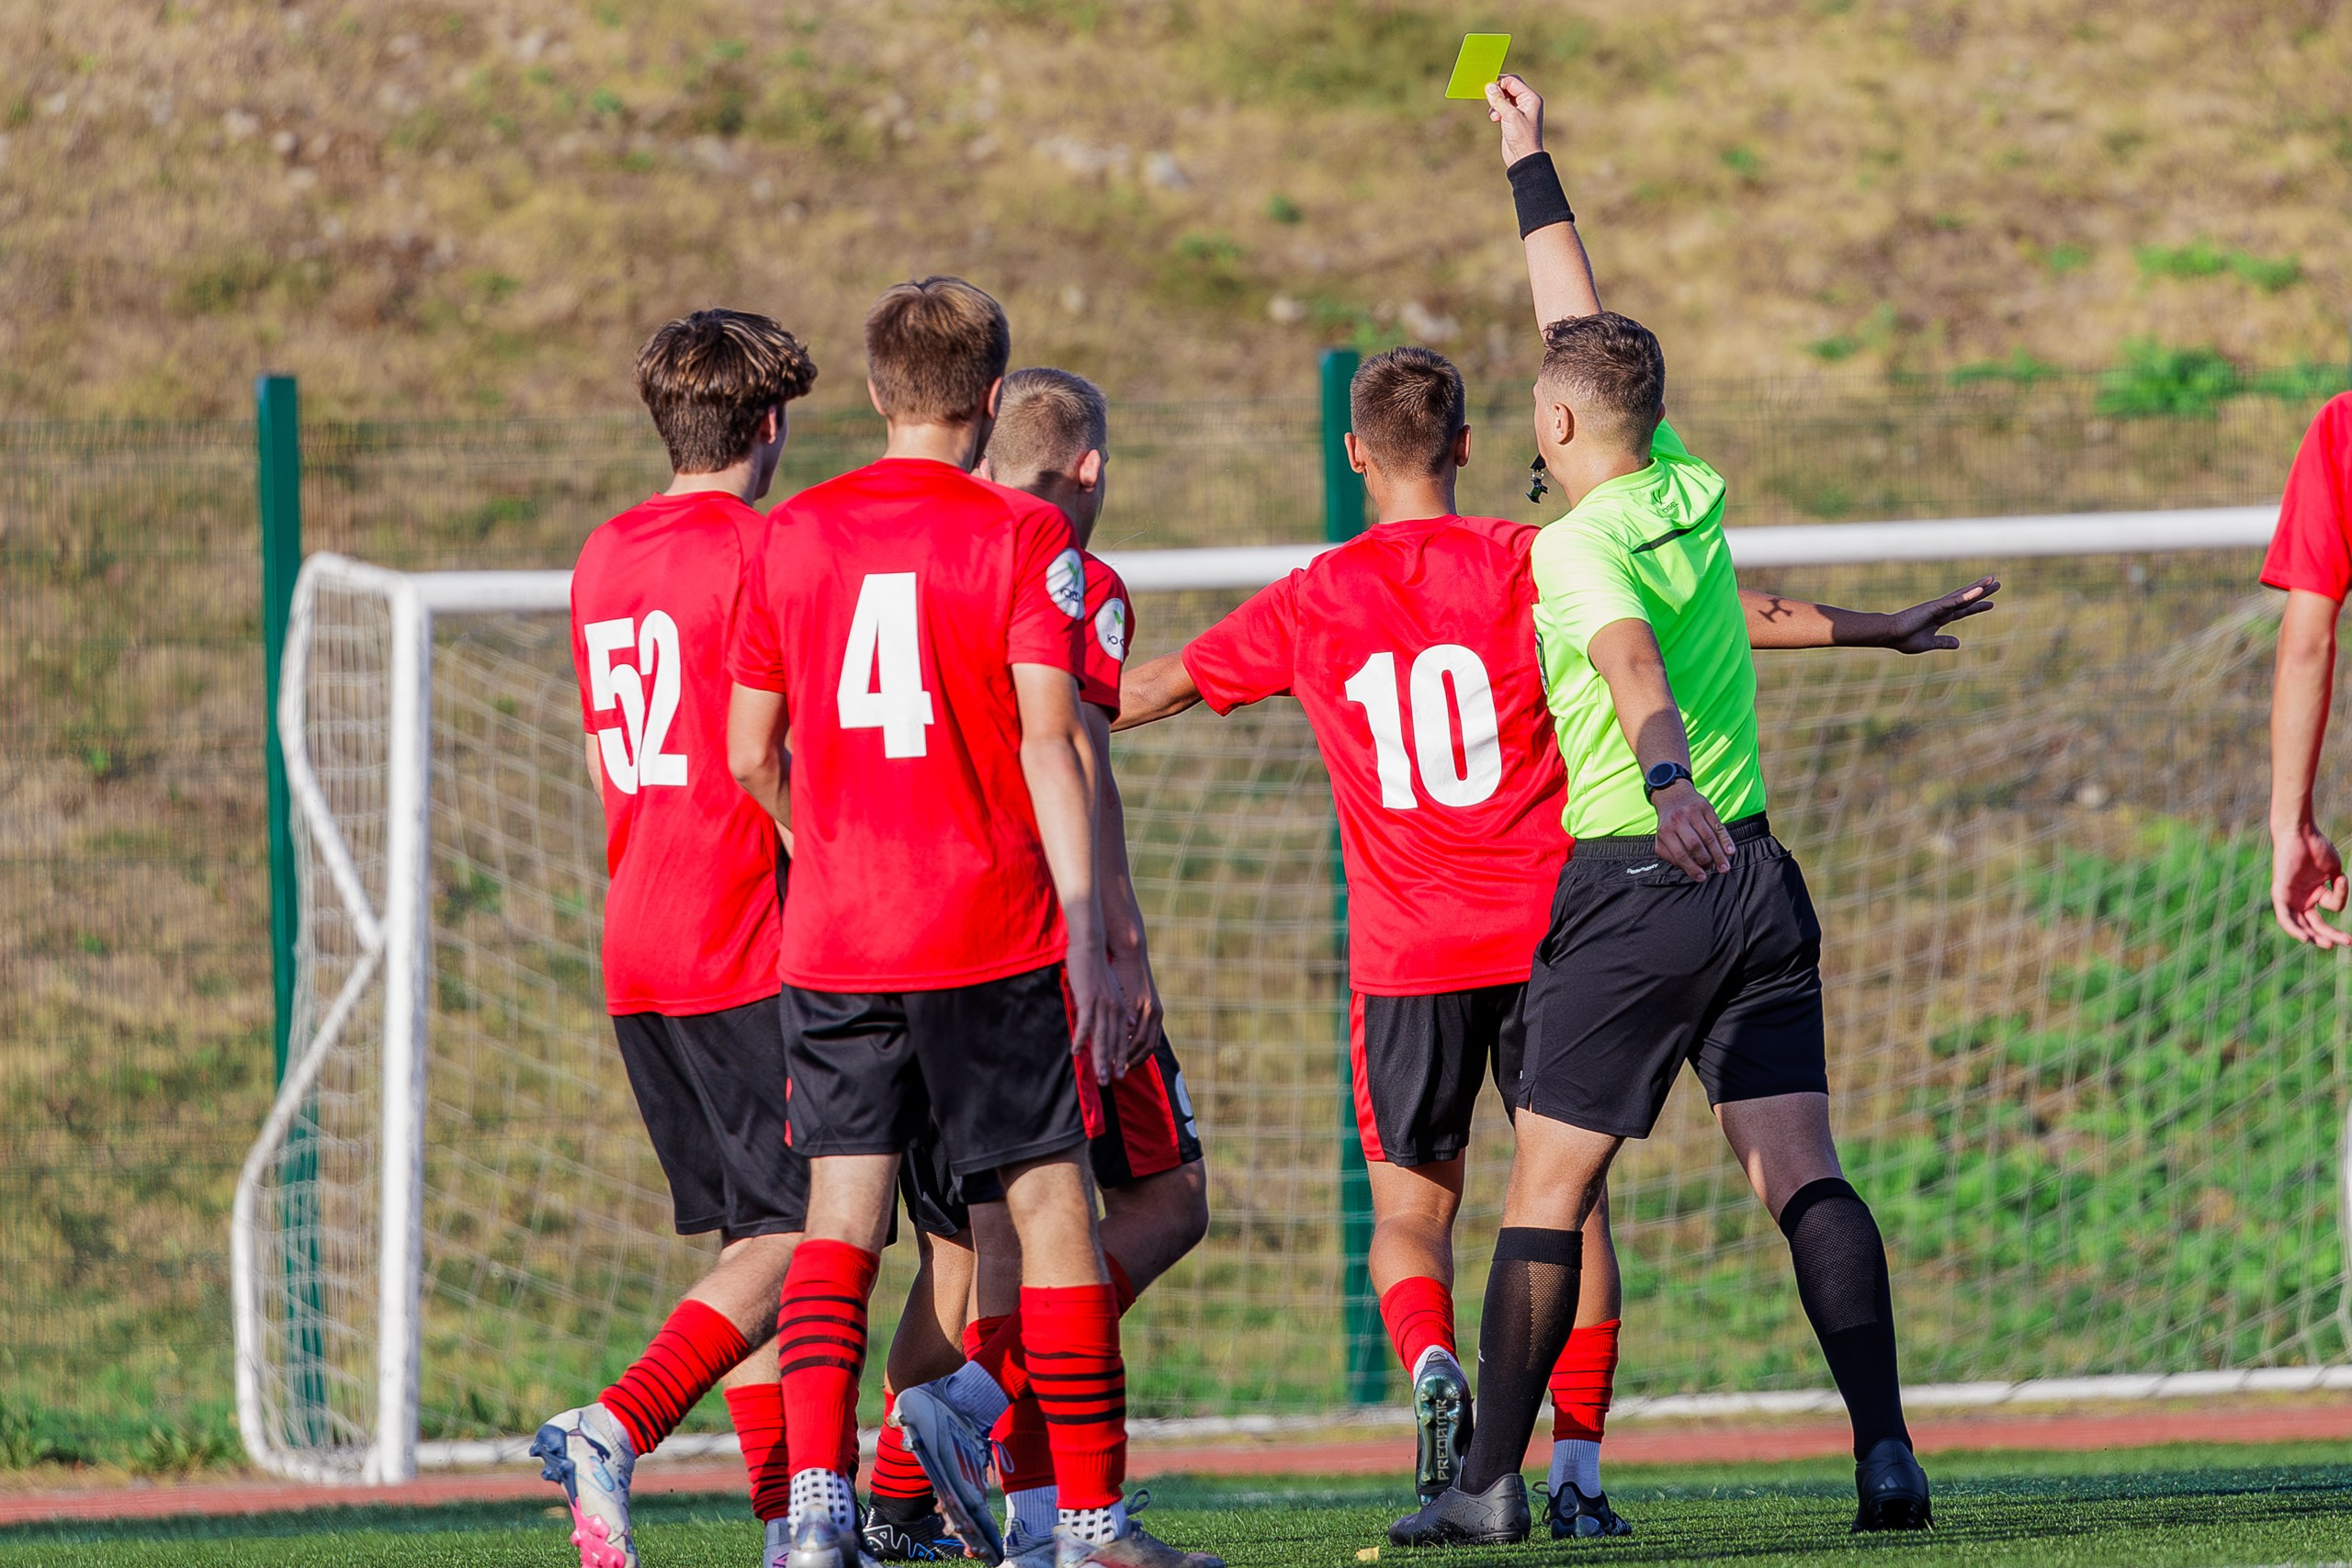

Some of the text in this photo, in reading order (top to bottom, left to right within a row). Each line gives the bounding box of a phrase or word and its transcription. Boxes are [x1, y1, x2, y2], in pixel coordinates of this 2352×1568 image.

[583, 609, 689, 795] 52
[837, 571, 934, 760] 4
[1344, 643, 1503, 810] 10
[1436, 1398, 1450, 1481] PREDATOR
